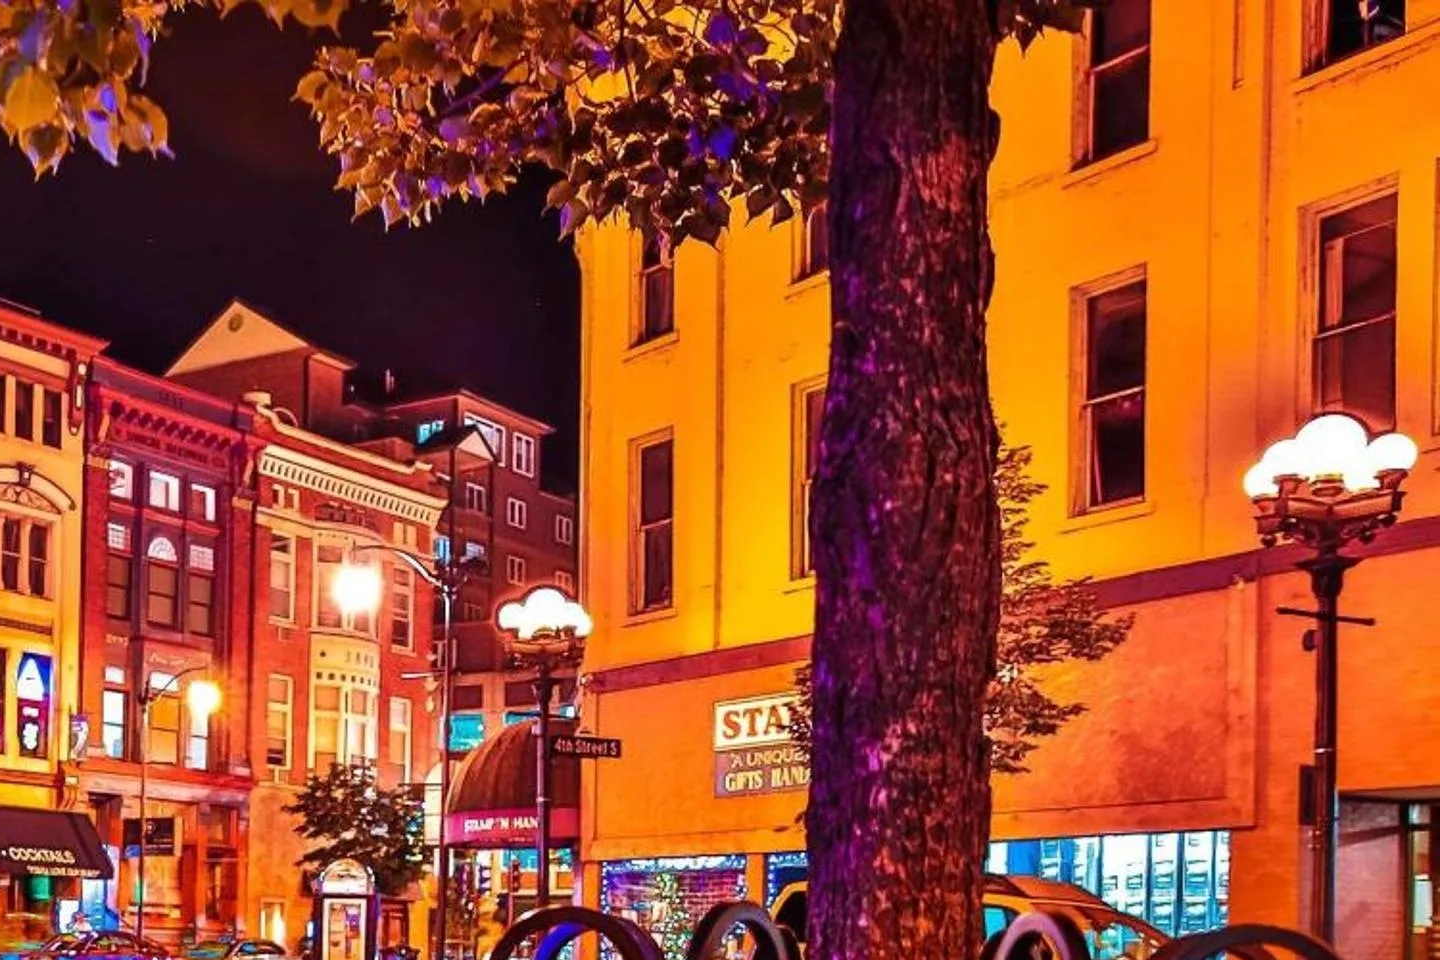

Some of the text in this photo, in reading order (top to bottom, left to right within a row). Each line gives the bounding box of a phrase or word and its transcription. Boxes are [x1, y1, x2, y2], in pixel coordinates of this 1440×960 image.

[723, 704, 784, 740] STA
[555, 739, 618, 756] 4th Street S
[725, 765, 811, 792] GIFTS HAND
[9, 847, 75, 863] COCKTAILS
